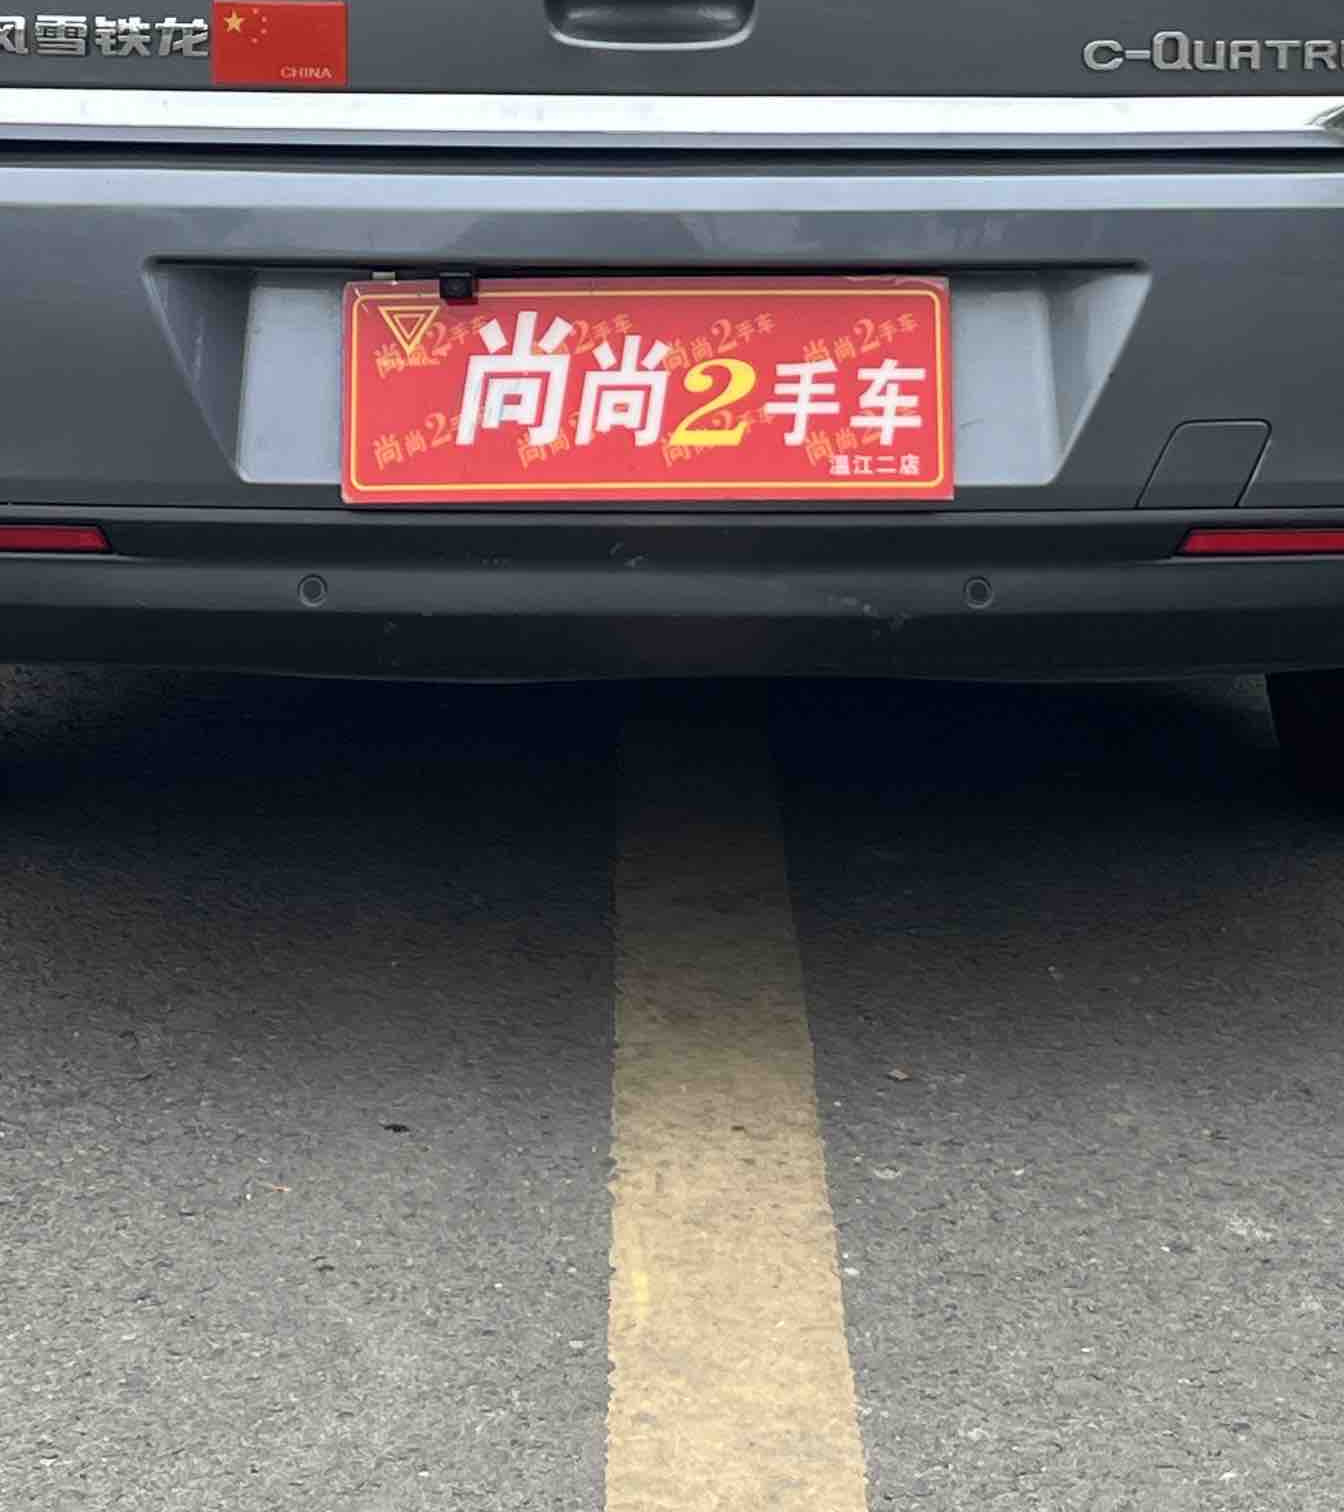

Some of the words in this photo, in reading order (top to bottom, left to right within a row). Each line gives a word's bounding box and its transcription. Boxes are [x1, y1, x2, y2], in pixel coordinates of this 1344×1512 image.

[279, 66, 333, 80] CHINA
[456, 310, 927, 446] 尚尚2手车
[830, 452, 921, 476] 温江二店
